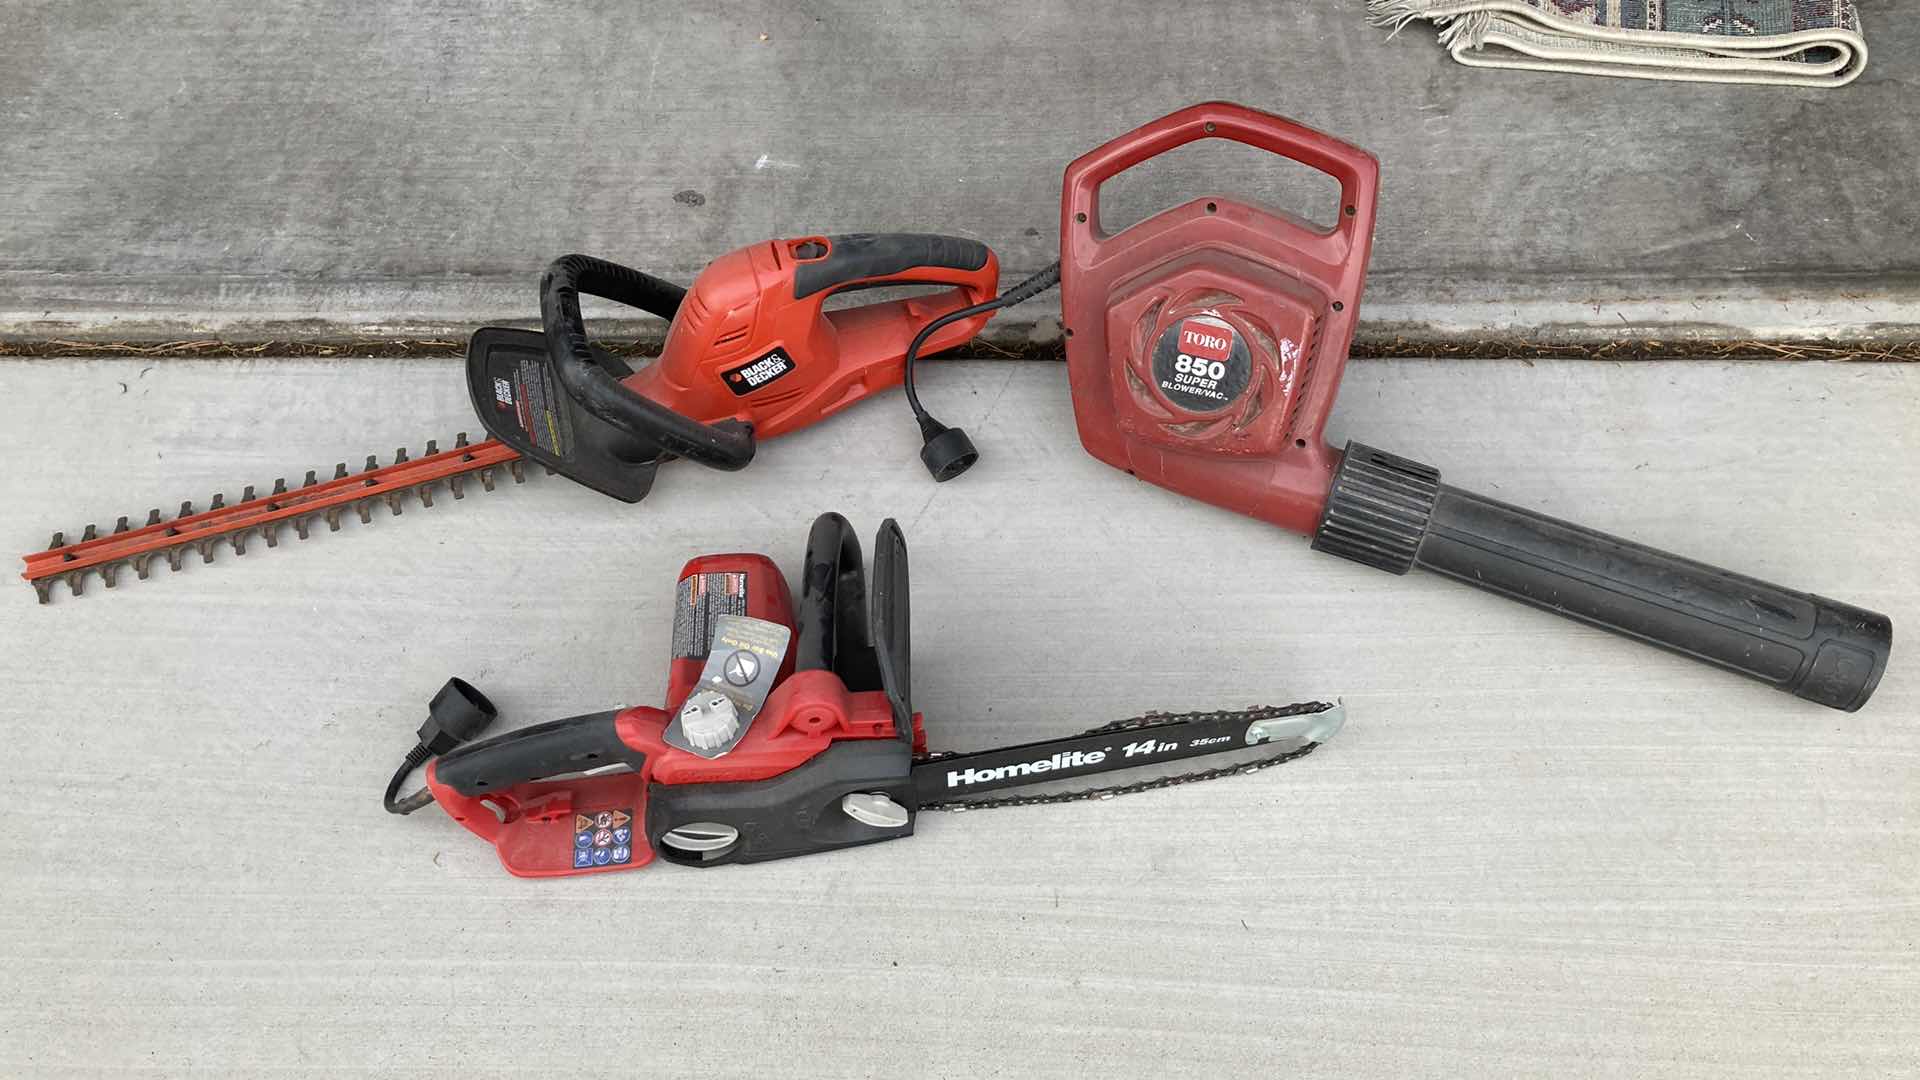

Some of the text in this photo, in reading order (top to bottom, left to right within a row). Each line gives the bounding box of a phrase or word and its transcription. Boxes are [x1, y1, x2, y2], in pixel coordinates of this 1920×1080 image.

[1183, 330, 1227, 350] TORO
[746, 361, 788, 387] DECKER
[1174, 354, 1226, 380] 850
[1174, 373, 1218, 390] SUPER
[947, 750, 1107, 787] Homelite
[1188, 735, 1231, 748] 35cm
